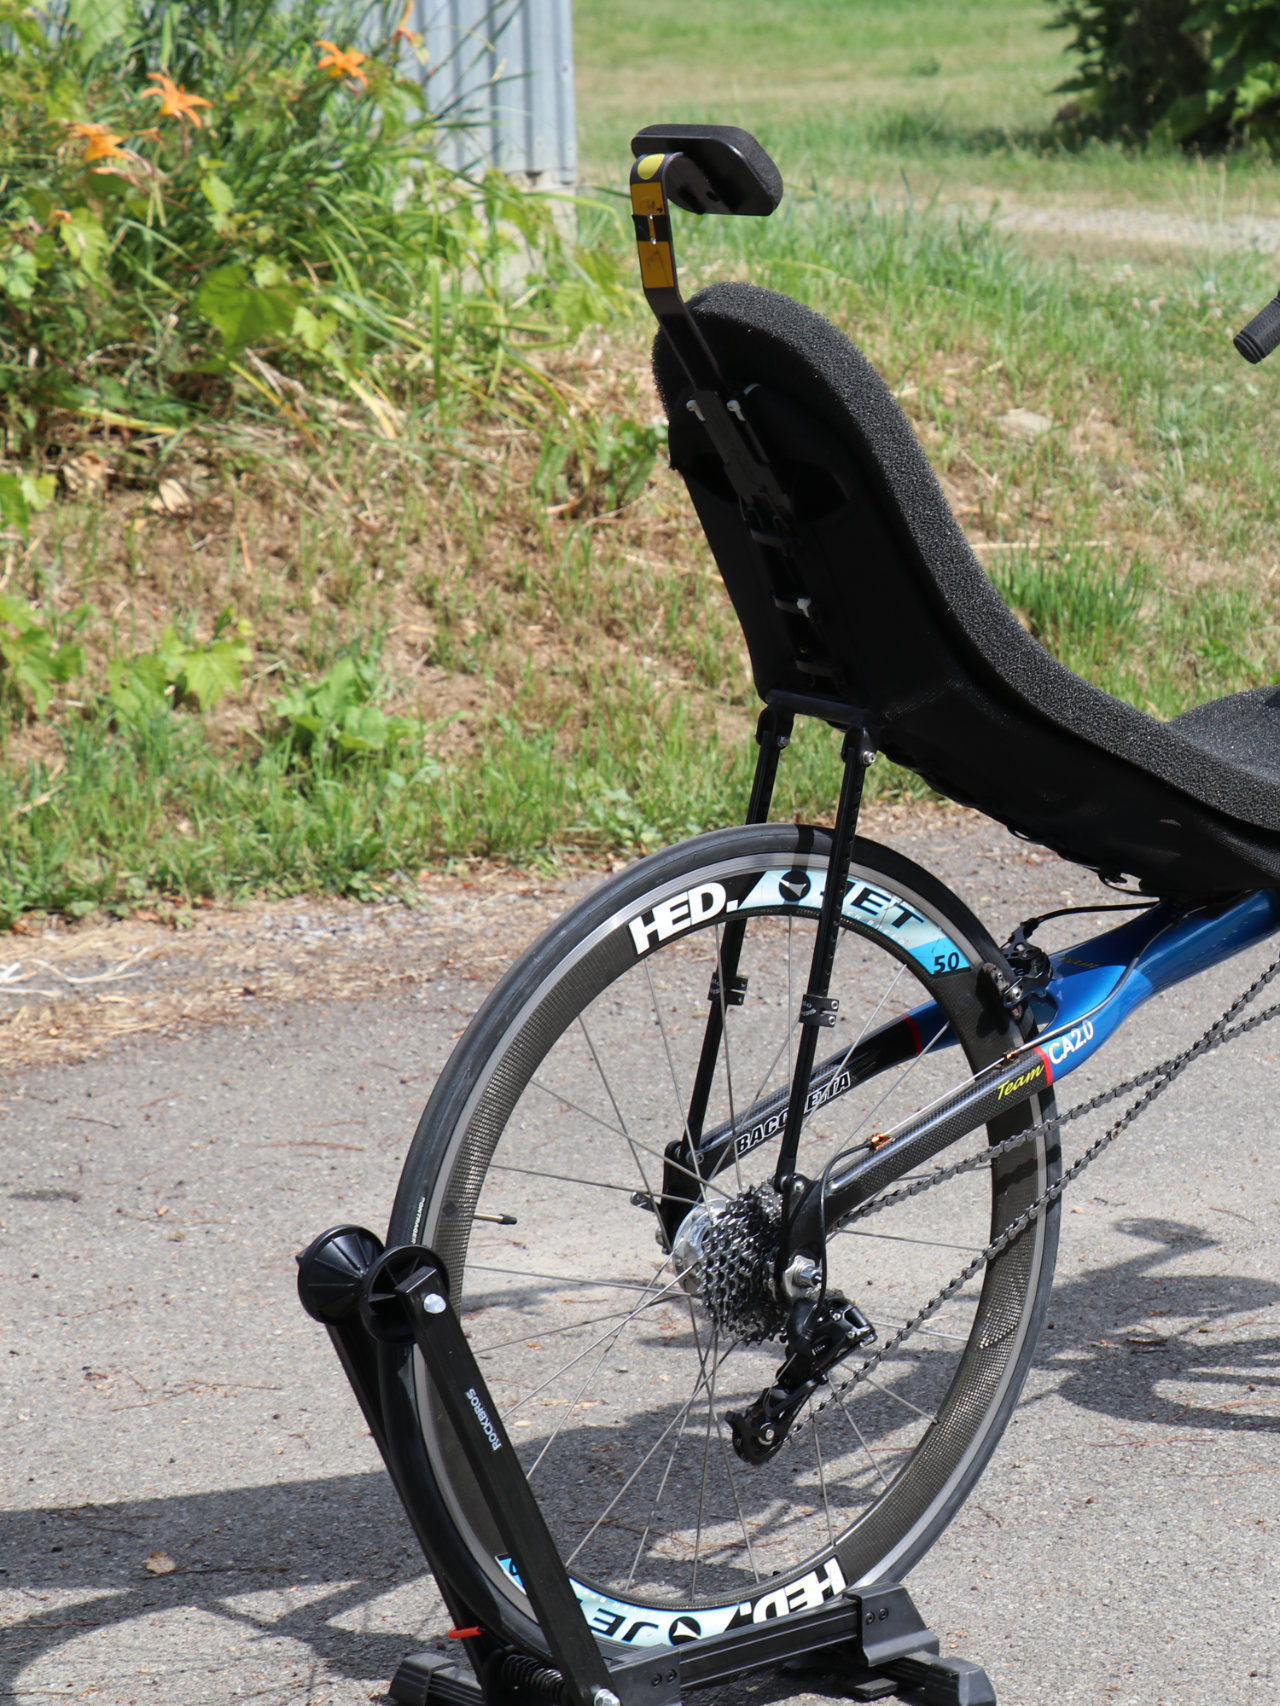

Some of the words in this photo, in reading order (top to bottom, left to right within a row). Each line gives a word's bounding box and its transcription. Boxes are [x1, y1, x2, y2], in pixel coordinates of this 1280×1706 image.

[933, 951, 960, 975] 50
[997, 1063, 1046, 1101] Team
[1048, 1019, 1095, 1065] CA2.0
[734, 1071, 851, 1156] BACCETTA
[464, 1387, 502, 1451] ROCKBROS
[588, 1607, 659, 1643] JE
